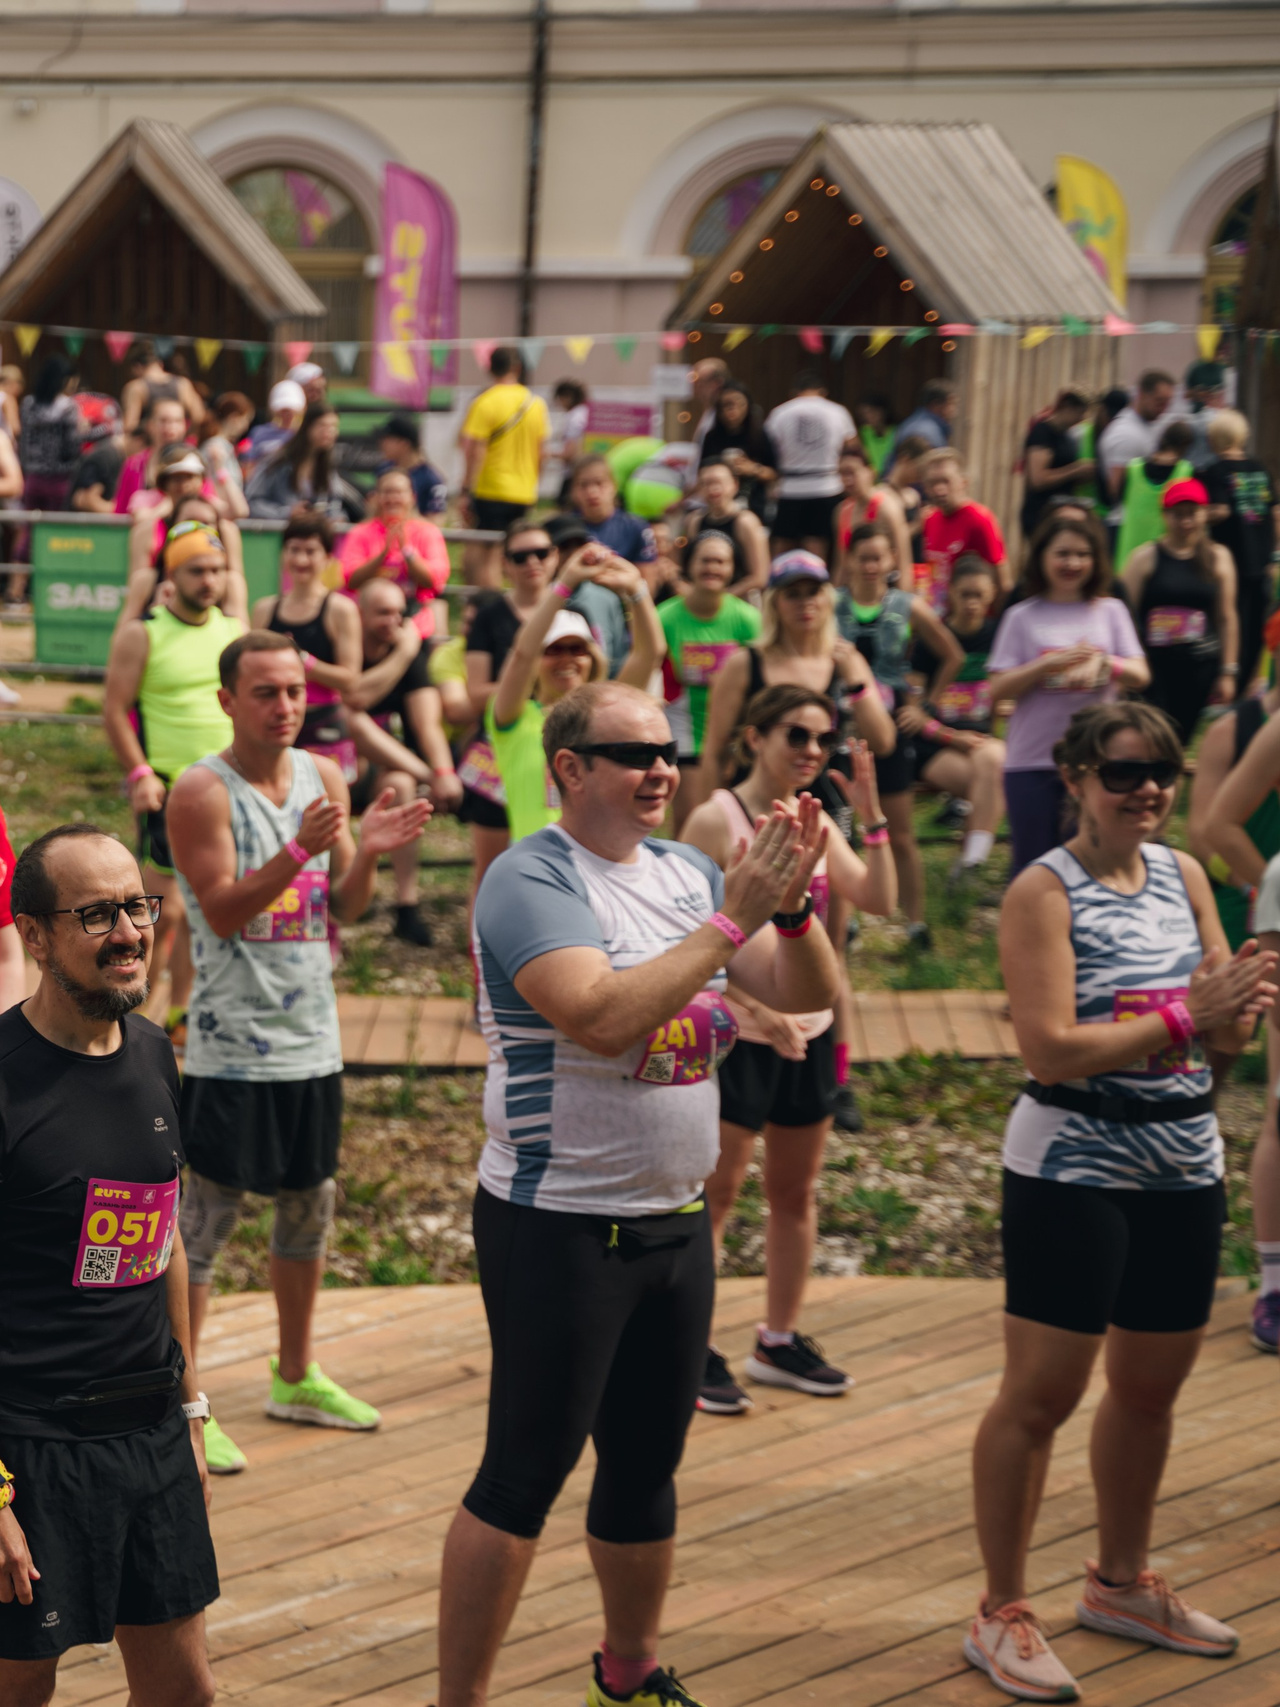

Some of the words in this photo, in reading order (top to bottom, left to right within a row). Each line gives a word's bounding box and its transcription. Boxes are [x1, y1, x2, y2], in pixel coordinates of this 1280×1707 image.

[649, 1016, 697, 1053] 241
[93, 1201, 120, 1209] КАЗАНЬ
[94, 1187, 131, 1200] RUTS
[86, 1209, 161, 1246] 051
